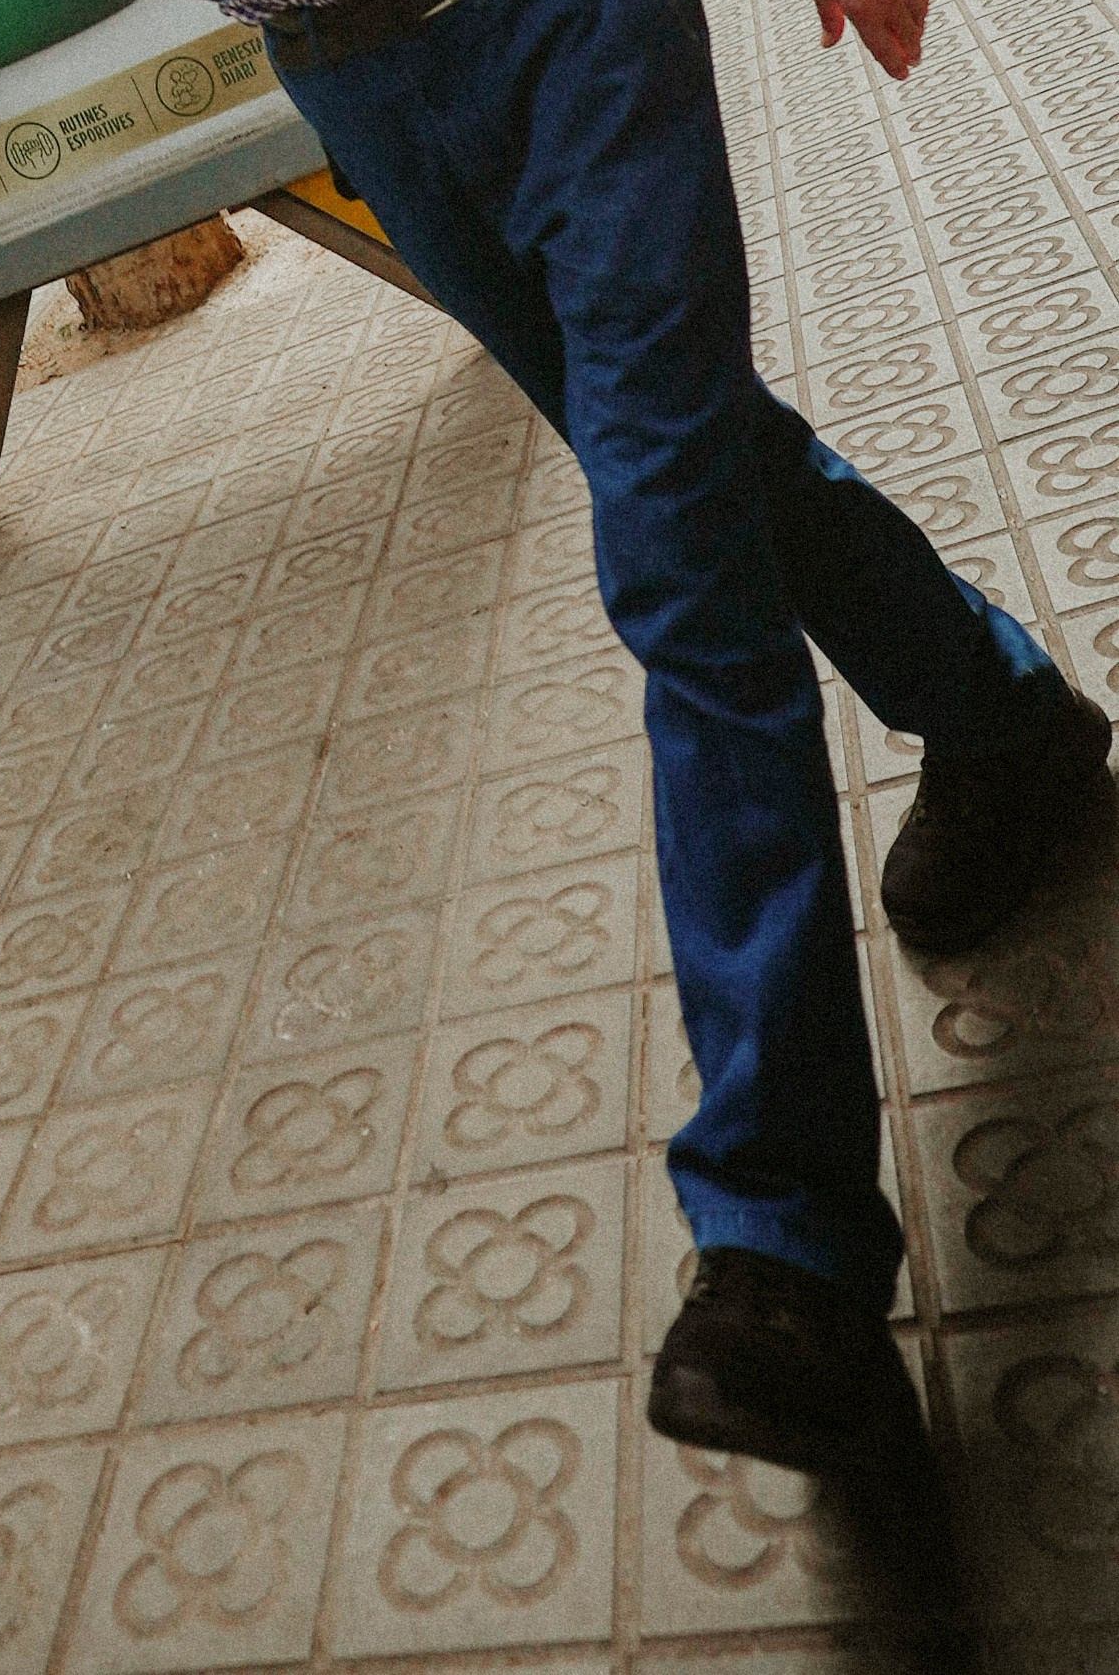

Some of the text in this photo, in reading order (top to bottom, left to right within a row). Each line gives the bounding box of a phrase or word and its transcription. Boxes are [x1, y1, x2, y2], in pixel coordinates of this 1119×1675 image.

[212, 37, 263, 69] BENESTA
[220, 61, 257, 88] DIARI
[58, 103, 109, 136] RUTINES
[66, 112, 135, 152] ESPORTIVES
